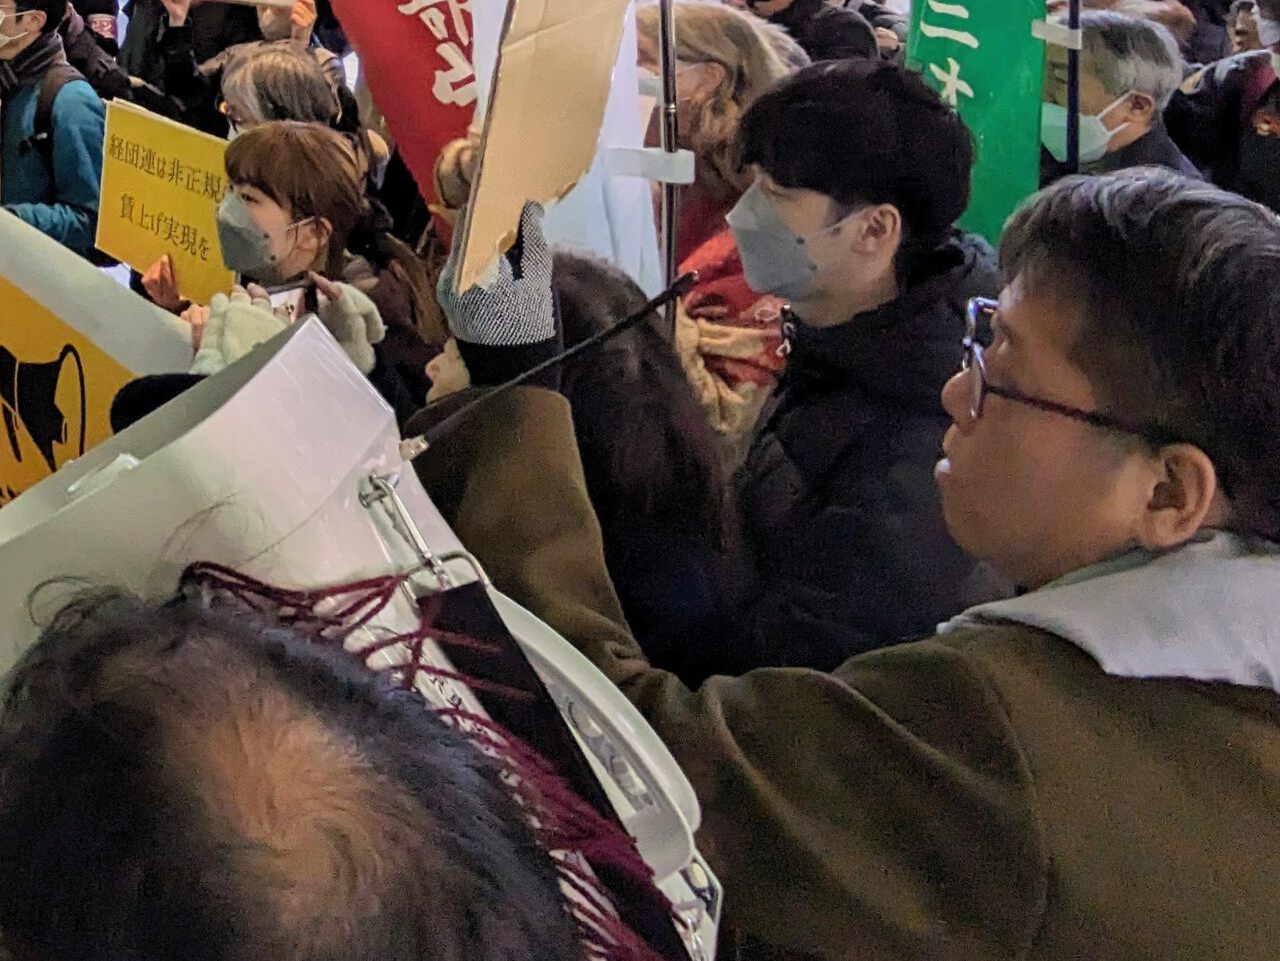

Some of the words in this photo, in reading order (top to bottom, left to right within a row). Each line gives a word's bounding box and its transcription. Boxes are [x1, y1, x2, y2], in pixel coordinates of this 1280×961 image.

[110, 133, 226, 203] 経団連は非正規
[120, 193, 211, 261] 賃上げ実現を
